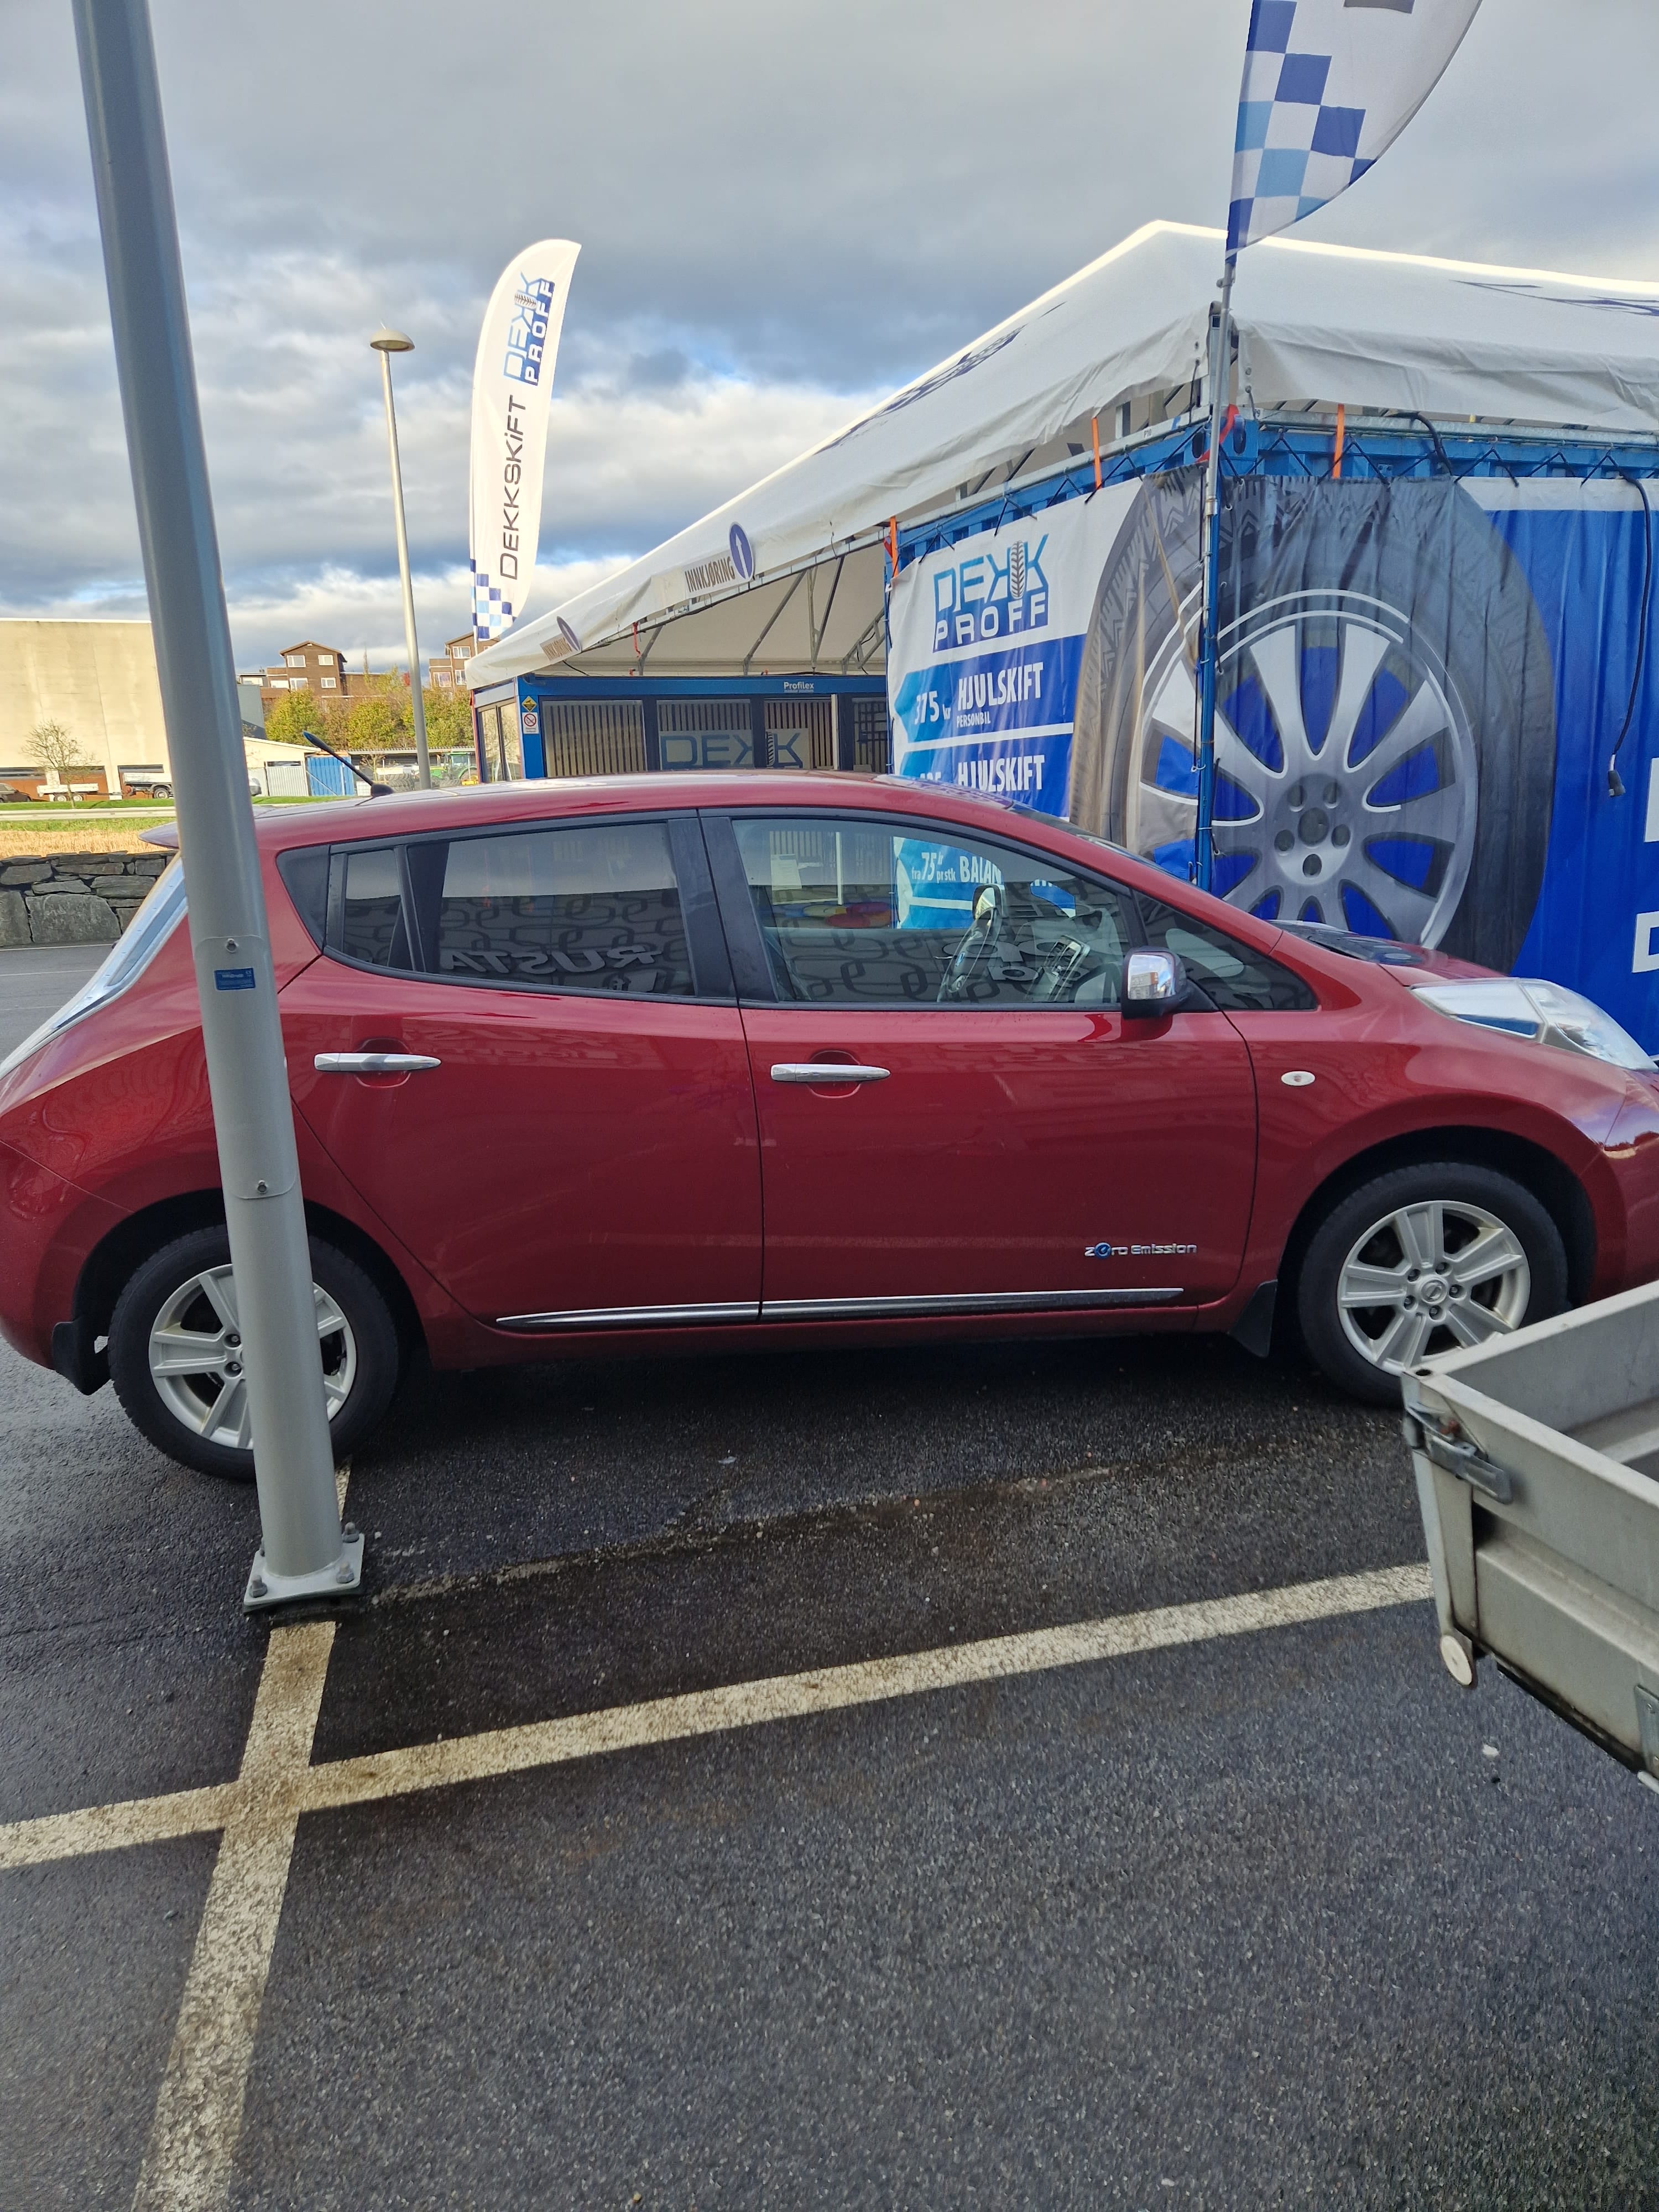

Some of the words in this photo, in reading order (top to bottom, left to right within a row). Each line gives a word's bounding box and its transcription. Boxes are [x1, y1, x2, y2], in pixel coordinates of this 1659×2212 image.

[525, 280, 554, 383] PROFF
[685, 556, 736, 593] INNKJØRING
[935, 592, 1046, 650] PROFF
[784, 681, 814, 690] Profilex
[957, 662, 1044, 711] HJULSKIFT
[956, 711, 991, 728] PERSONBIL
[958, 755, 1045, 792] HJULSKIFT
[912, 867, 921, 880] fra
[921, 852, 936, 881] 75
[1131, 1243, 1197, 1255] Emission
